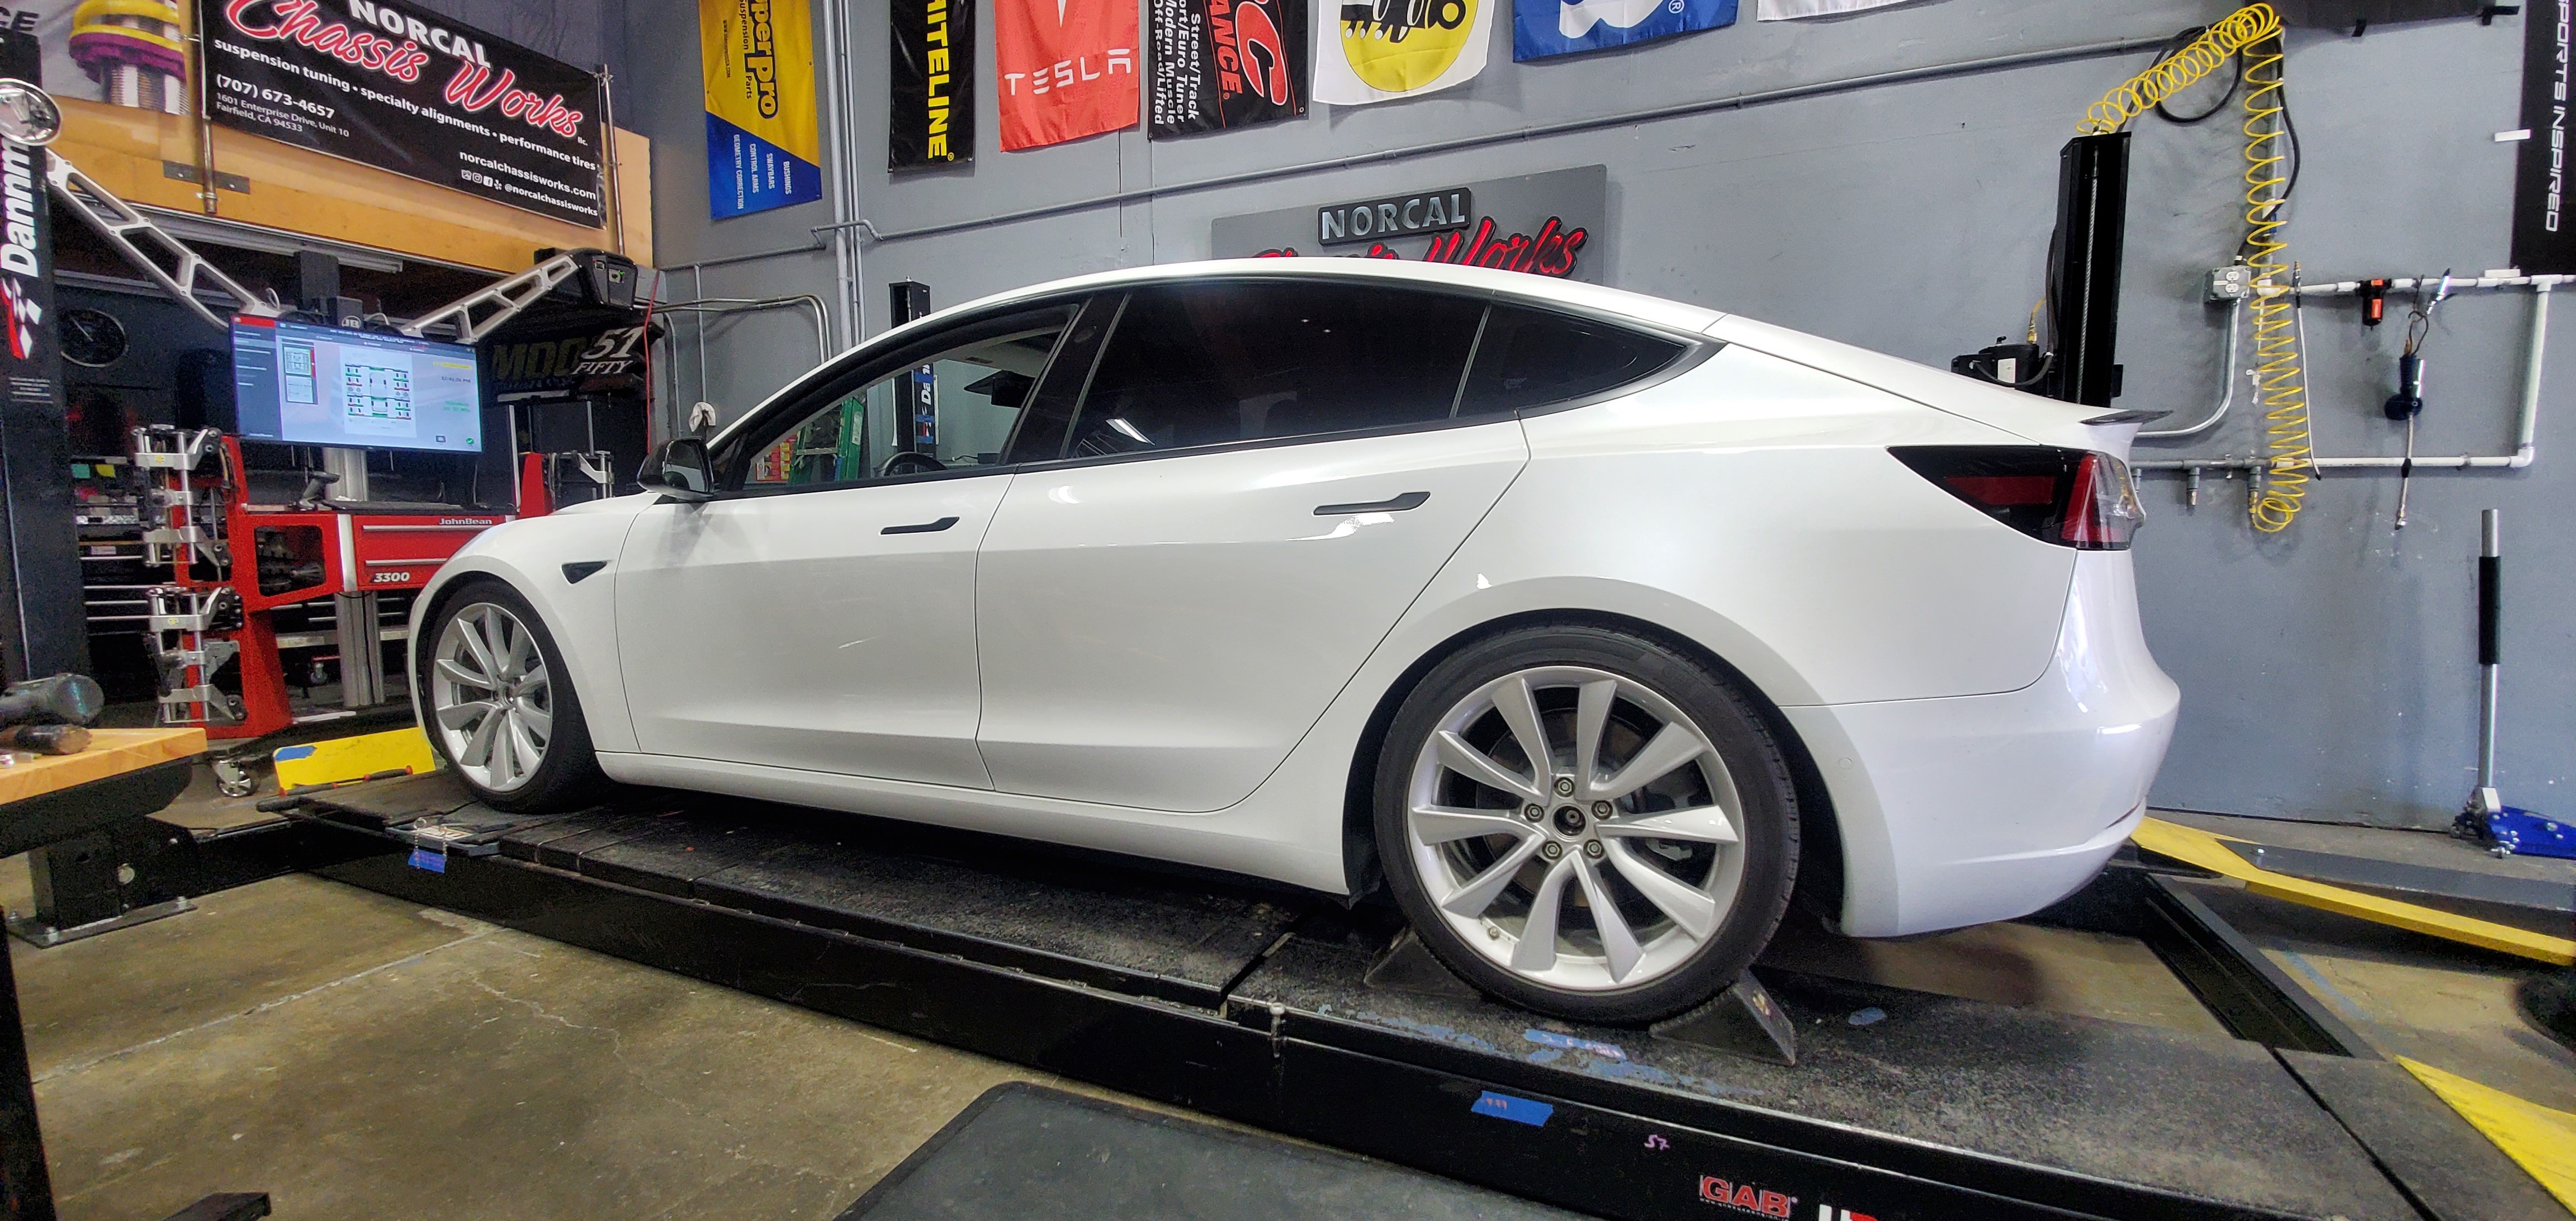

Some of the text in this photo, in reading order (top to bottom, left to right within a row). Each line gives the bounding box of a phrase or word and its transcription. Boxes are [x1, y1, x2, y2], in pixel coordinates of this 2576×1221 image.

[348, 0, 492, 68] NORCAL
[226, 0, 583, 138] Chassis Works
[745, 0, 778, 119] perPro
[1005, 48, 1131, 96] TESLA
[1188, 13, 1201, 120] Street/Track
[215, 39, 596, 171] suspension tuning specialty alignments performance tires
[216, 74, 335, 119] (707) 673-4657
[217, 93, 349, 138] 1601 Enterprise Drive, Unit 10
[1165, 62, 1176, 124] Muscle
[1176, 74, 1188, 122] Tuner
[2545, 0, 2569, 232] PORTS INSPIRED
[217, 102, 303, 132] Fairfield, CA 94533
[460, 152, 596, 200] norcalchassisworks.com
[733, 134, 744, 210] GEOMETRY CORRECTION
[750, 143, 758, 173] CONTROL
[766, 153, 775, 190] SWAYBARS
[783, 161, 792, 195] BUSHINGS
[504, 183, 598, 216] @norcalchassisworks
[1322, 193, 1465, 240] NORCAL
[1422, 216, 1587, 276] Works
[581, 326, 645, 359] 51
[570, 361, 633, 375] FIFTY
[373, 571, 410, 583] 3300
[1702, 1176, 1789, 1218] GAB
